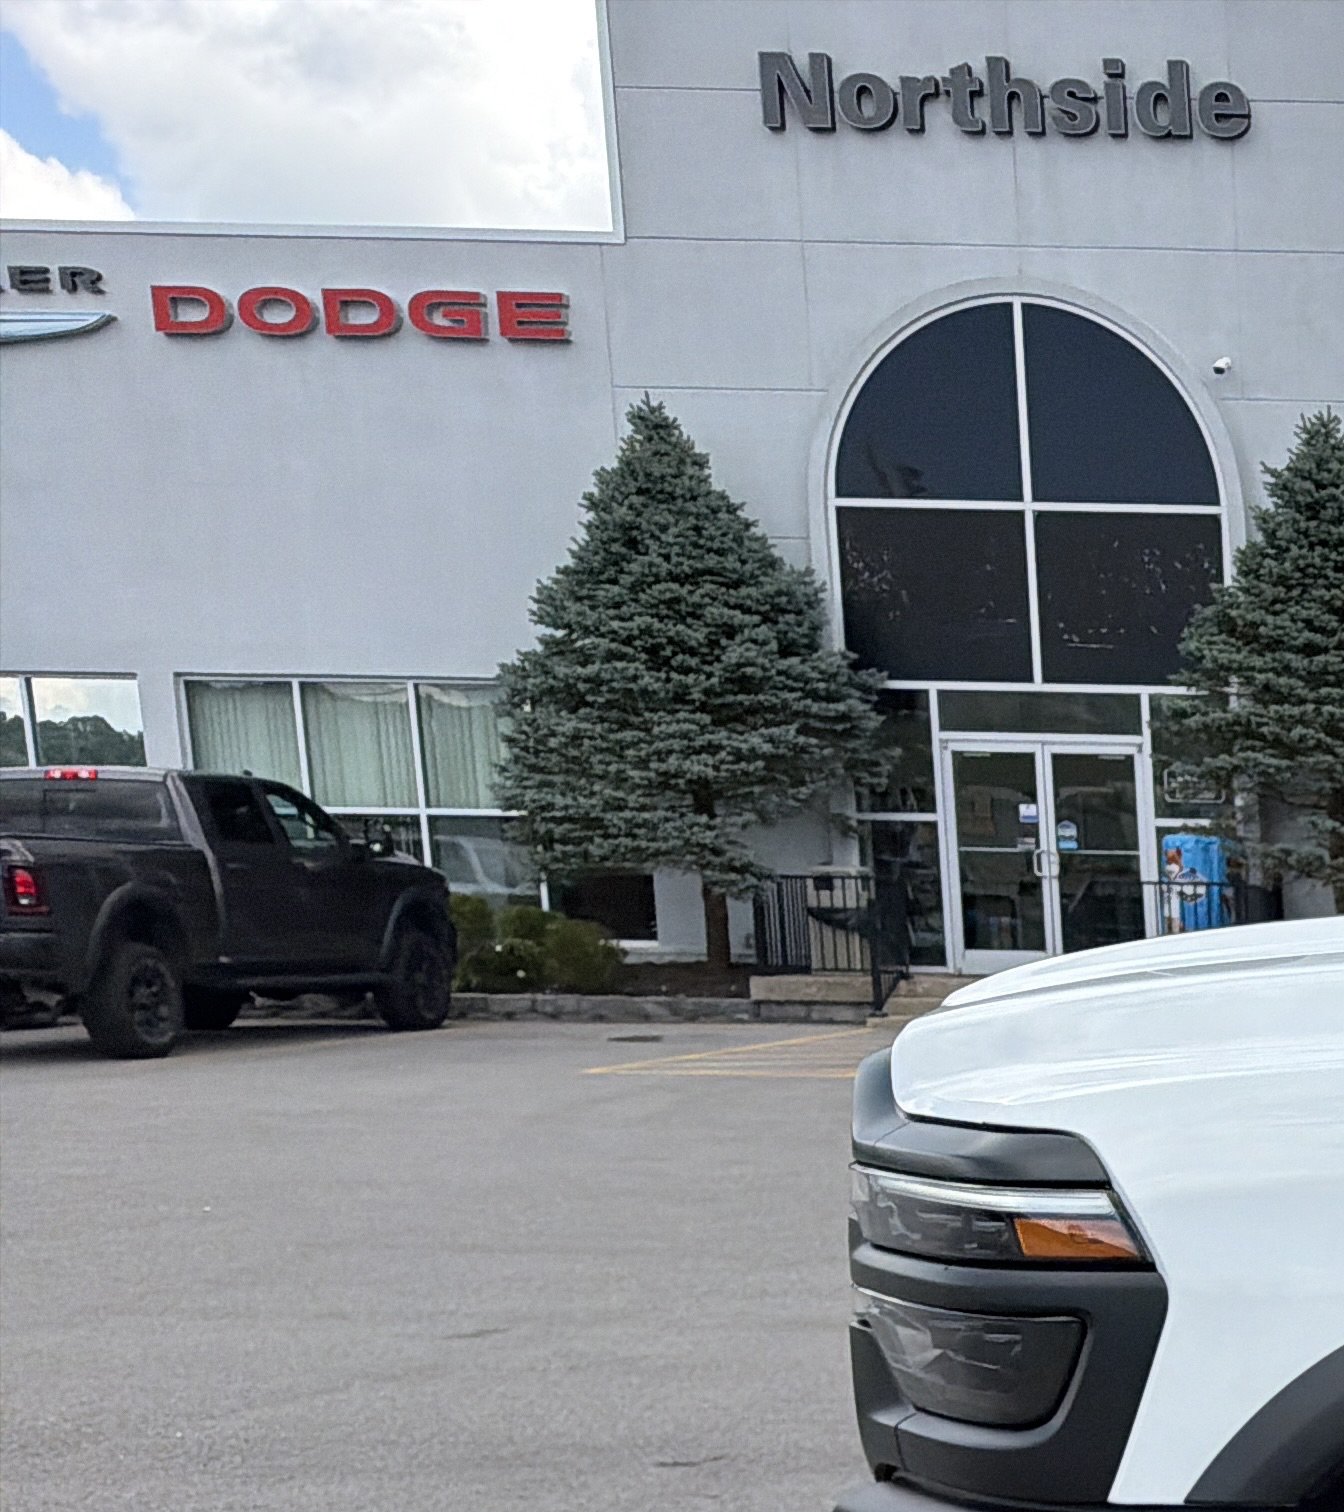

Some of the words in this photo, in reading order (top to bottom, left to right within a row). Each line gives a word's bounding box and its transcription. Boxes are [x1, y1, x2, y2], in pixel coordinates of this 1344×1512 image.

[758, 51, 1252, 138] Northside
[0, 265, 106, 295] ER
[150, 285, 572, 342] DODGE
